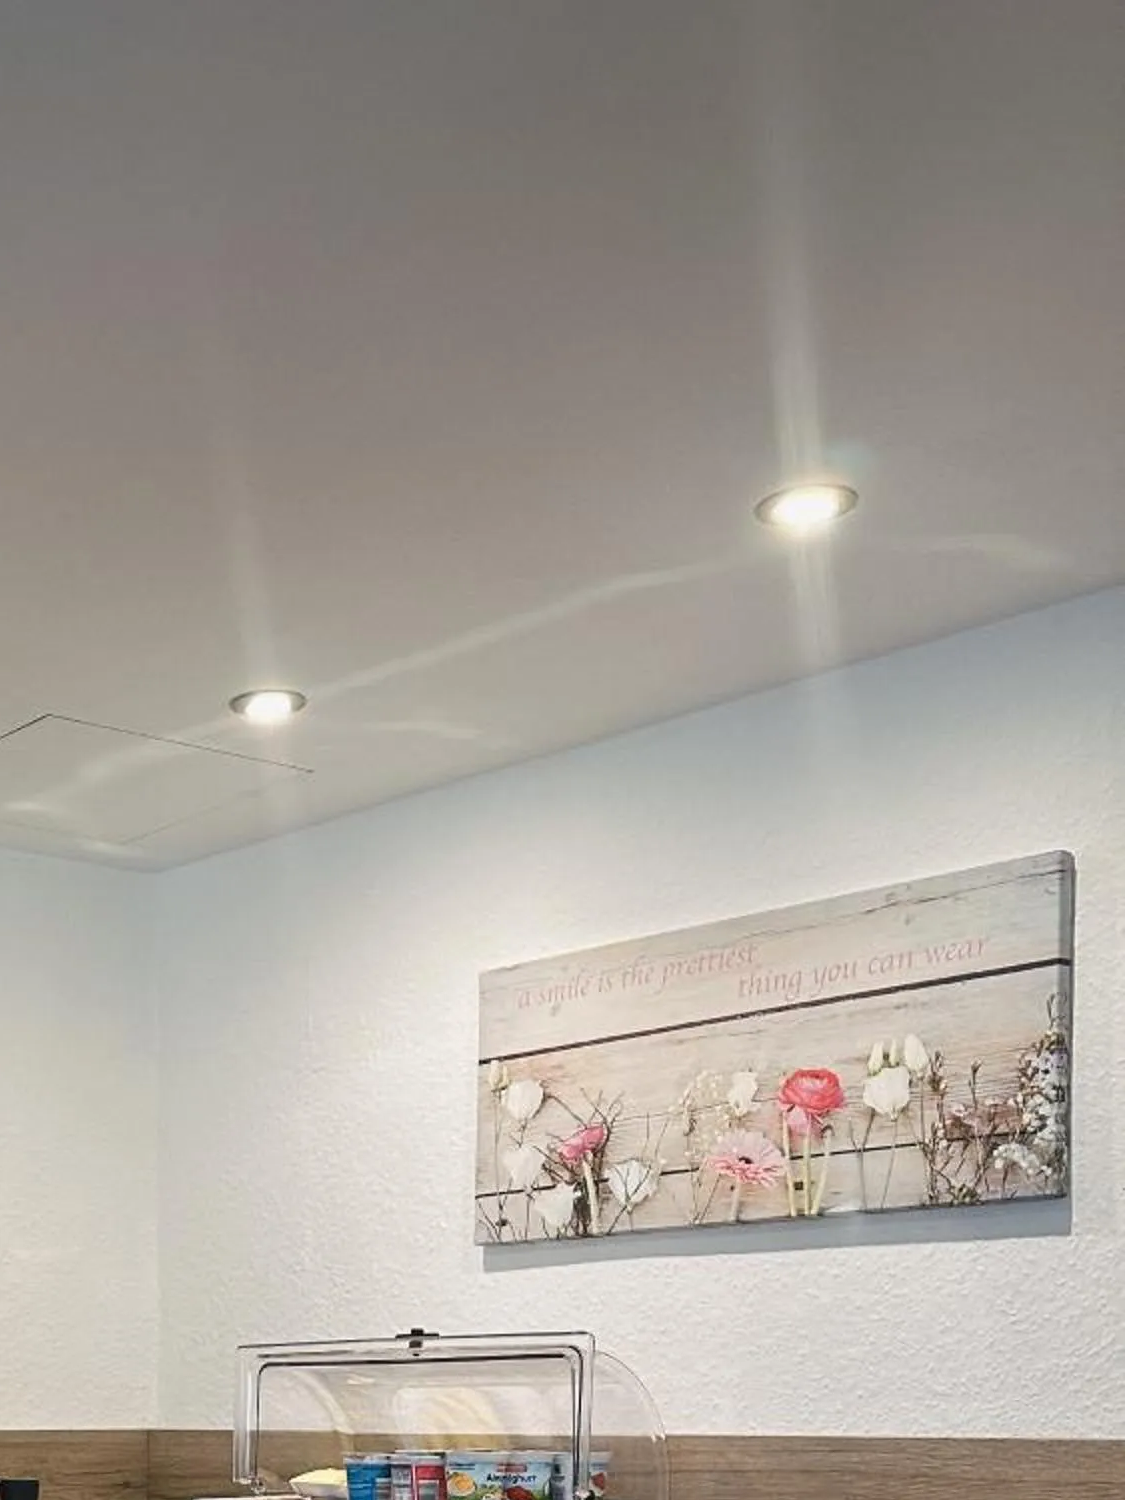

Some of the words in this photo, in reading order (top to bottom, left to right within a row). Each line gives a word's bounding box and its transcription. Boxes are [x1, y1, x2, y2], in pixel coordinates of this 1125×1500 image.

[517, 989, 533, 1010] a
[537, 970, 592, 1004] smile
[597, 972, 614, 995] is
[621, 953, 653, 989] the
[652, 944, 759, 995] prettiest
[737, 963, 803, 1001] thing
[810, 959, 859, 993] you
[868, 949, 913, 976] can
[922, 935, 989, 964] wear
